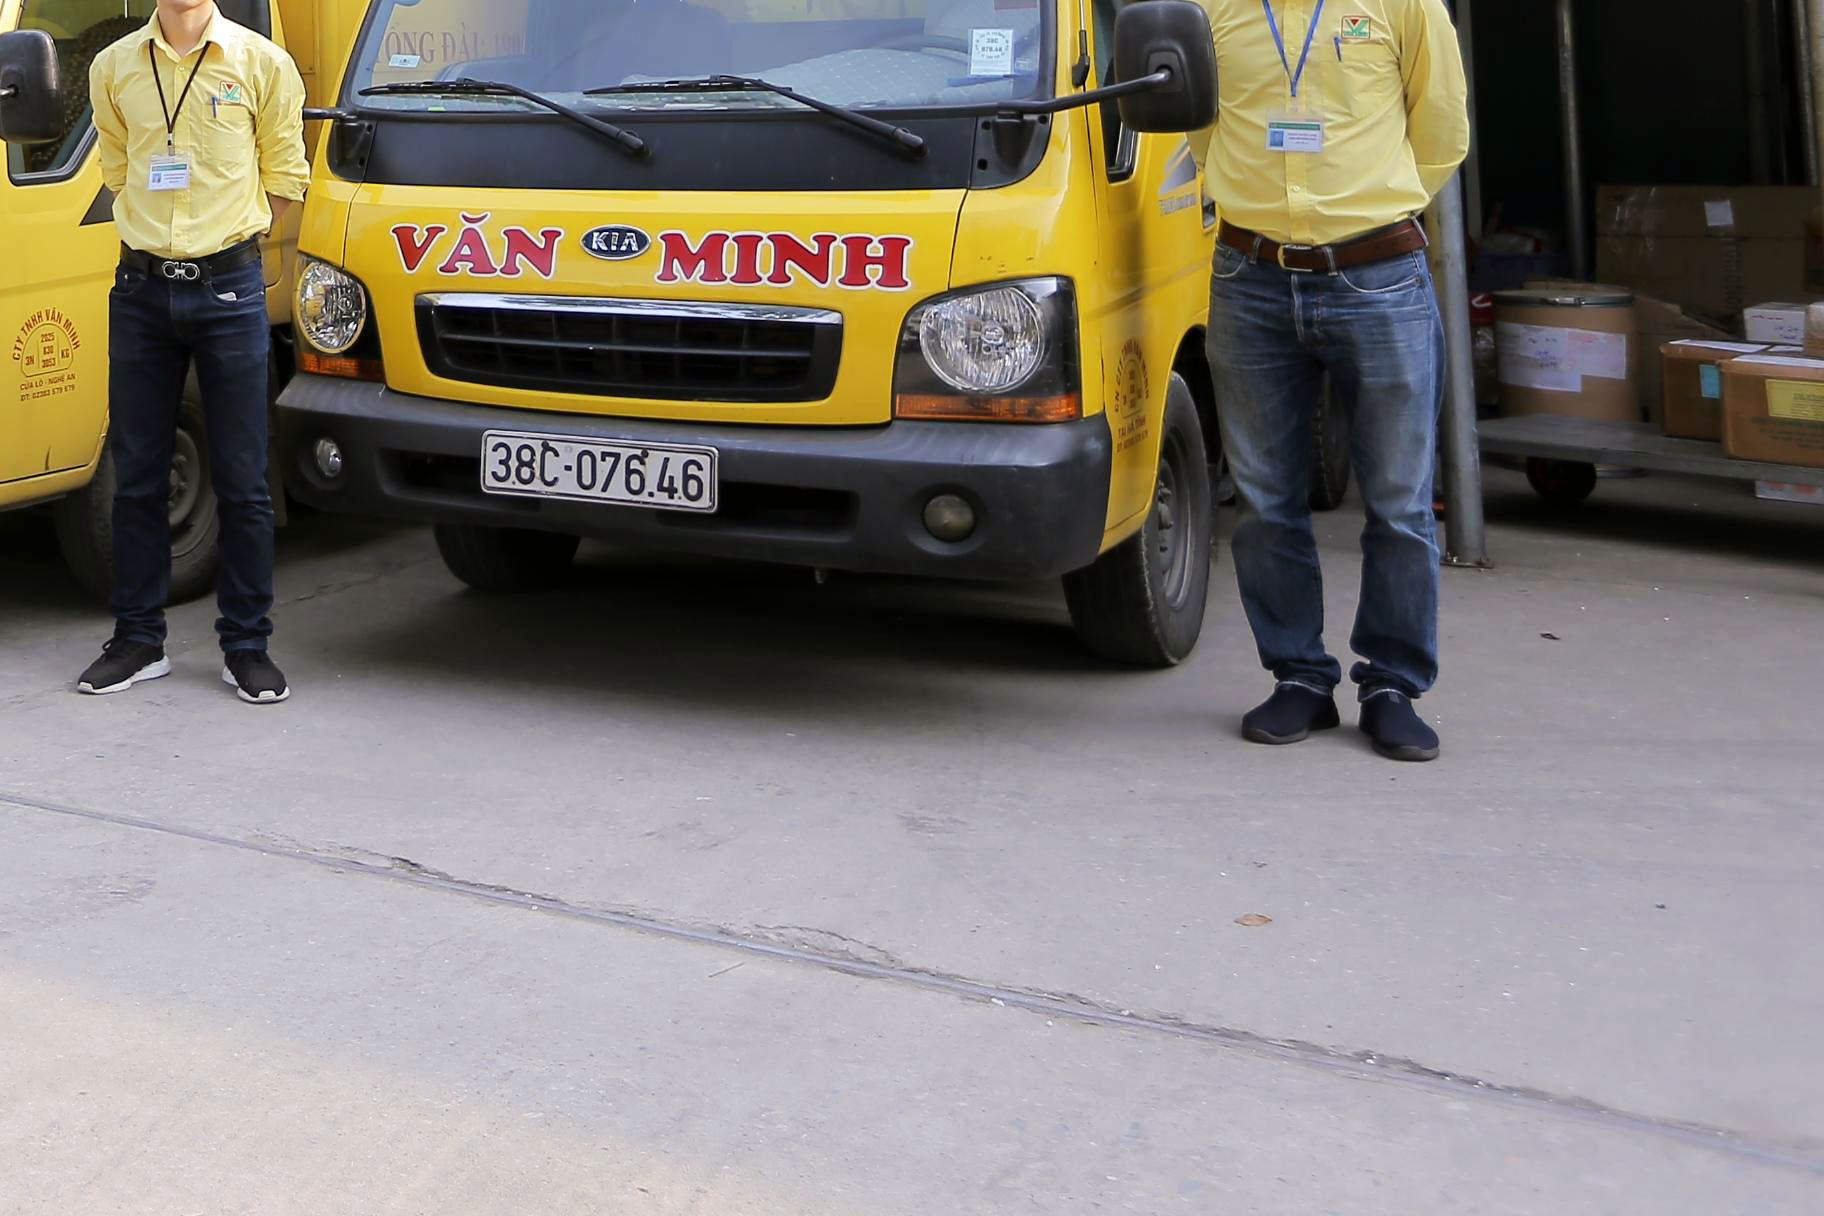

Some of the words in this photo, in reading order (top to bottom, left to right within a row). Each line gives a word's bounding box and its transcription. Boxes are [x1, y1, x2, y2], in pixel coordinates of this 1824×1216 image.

[391, 211, 562, 278] VĂN
[589, 230, 639, 252] KIA
[656, 232, 912, 288] MINH
[12, 335, 24, 361] CTY
[20, 310, 44, 336] TNHH
[63, 318, 81, 351] MINH
[25, 355, 35, 366] 3N
[61, 348, 70, 359] KG
[66, 372, 76, 381] AN
[490, 440, 704, 503] 38C-076.46
